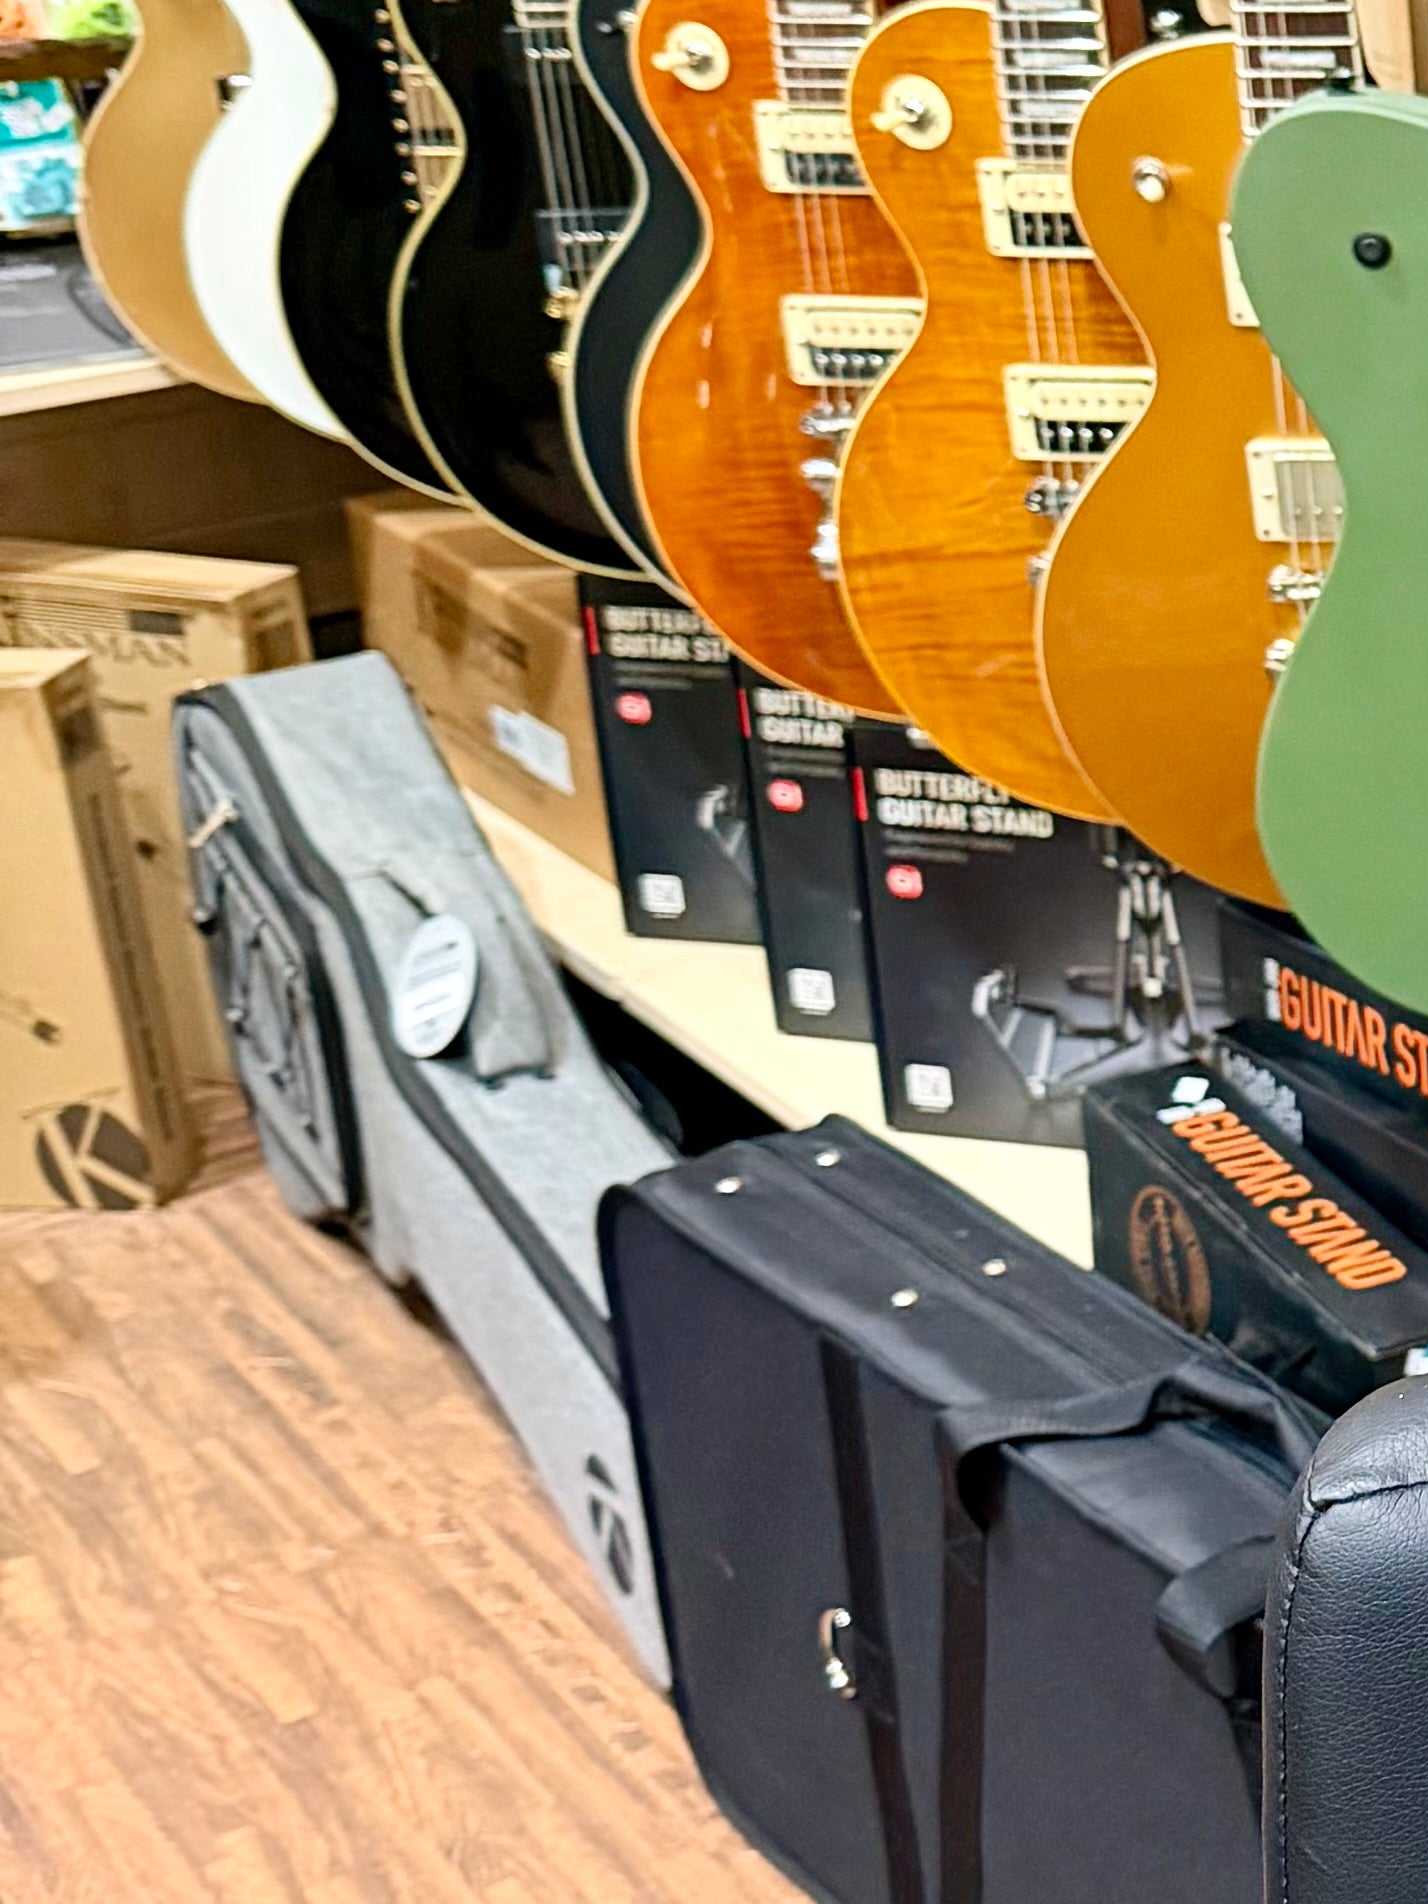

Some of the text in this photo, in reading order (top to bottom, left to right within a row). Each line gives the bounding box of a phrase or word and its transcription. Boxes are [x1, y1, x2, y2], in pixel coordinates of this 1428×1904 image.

[878, 797, 1054, 838] GUITAR STAND
[1279, 966, 1389, 1075] GUITAR
[1172, 1111, 1407, 1290] GUITAR STAND
